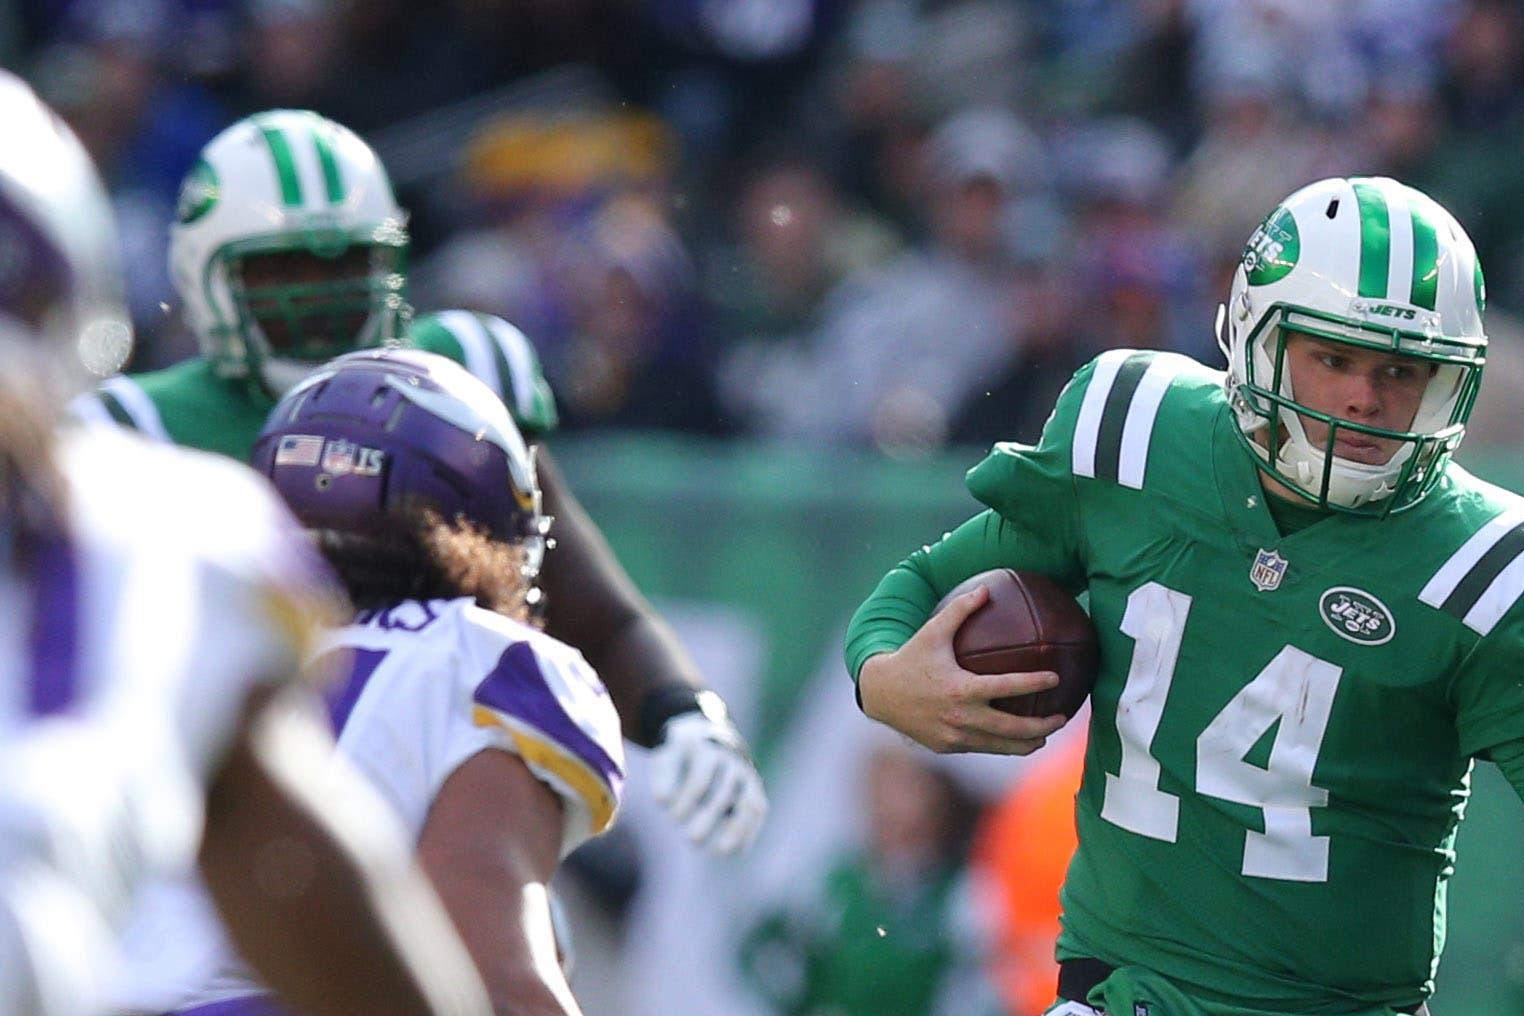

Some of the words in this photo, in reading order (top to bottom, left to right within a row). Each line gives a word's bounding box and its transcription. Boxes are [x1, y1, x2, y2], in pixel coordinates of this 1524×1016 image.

[1369, 303, 1417, 320] JETS
[1255, 564, 1279, 585] NFL
[1100, 581, 1343, 882] 14
